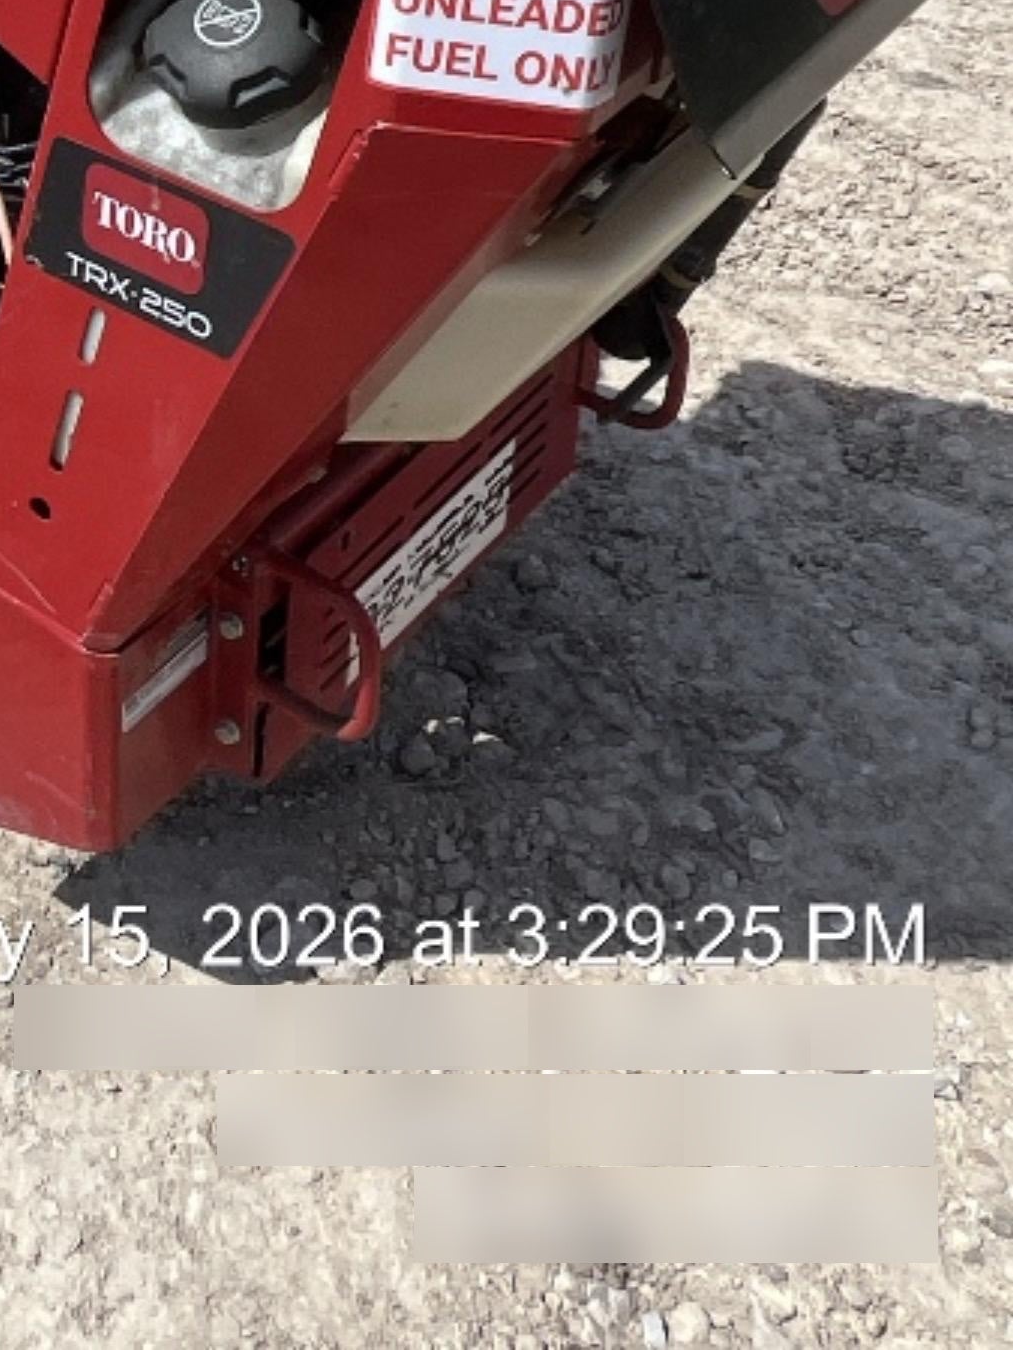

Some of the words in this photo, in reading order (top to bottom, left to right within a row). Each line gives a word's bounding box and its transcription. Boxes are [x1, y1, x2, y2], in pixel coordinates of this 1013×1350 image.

[385, 33, 498, 81] FUEL
[514, 50, 615, 91] ONLY
[92, 190, 197, 262] TORO
